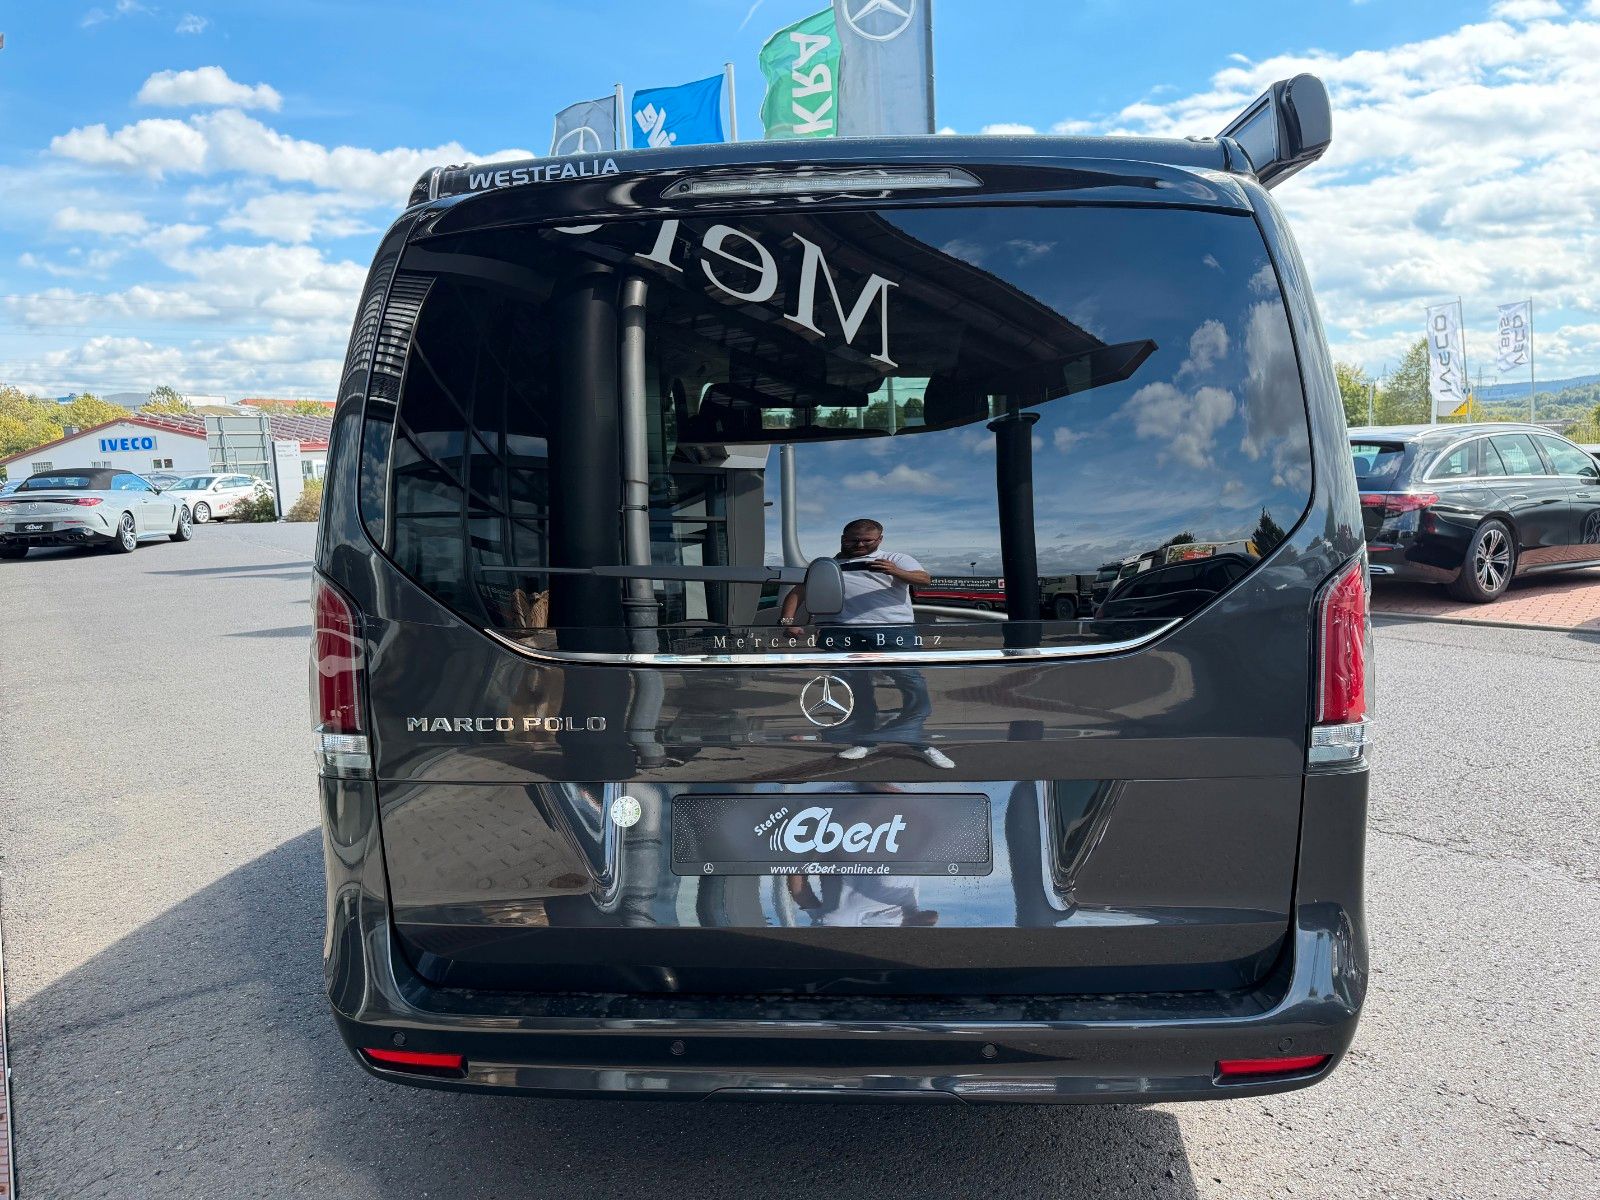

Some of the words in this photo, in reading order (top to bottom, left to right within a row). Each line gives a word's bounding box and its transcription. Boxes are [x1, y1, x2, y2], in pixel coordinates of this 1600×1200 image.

[469, 158, 620, 190] WESTFALIA
[101, 437, 153, 451] IVECO
[713, 634, 942, 649] Mercedes-Benz
[406, 716, 515, 732] MARCO
[523, 716, 608, 732] POLO
[754, 806, 789, 837] Stefan
[784, 806, 907, 853] Ebert
[770, 862, 890, 874] www.Ebert-online.de
